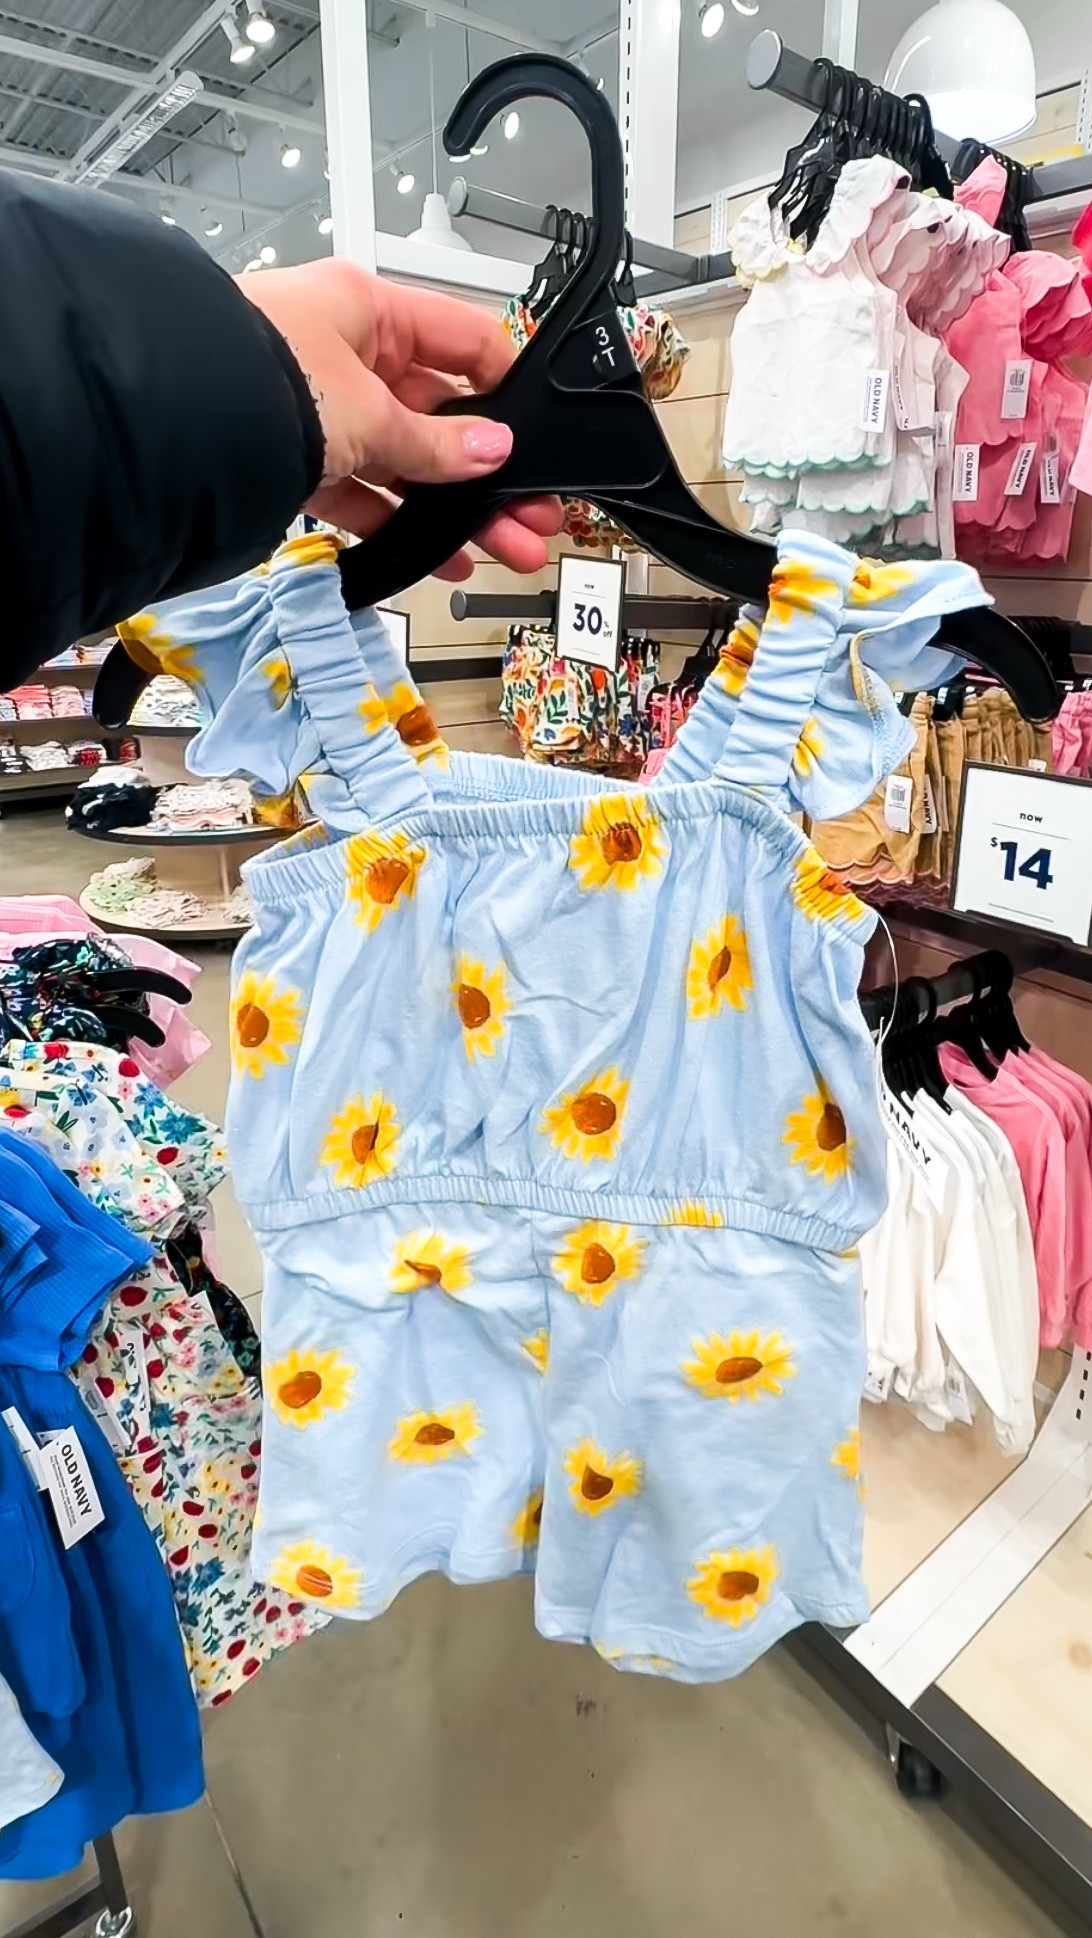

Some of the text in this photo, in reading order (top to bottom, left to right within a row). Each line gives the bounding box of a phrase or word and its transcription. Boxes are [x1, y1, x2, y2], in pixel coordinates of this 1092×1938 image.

[870, 377, 883, 424] OLD NAVY
[965, 451, 974, 493] OLD NAVY
[1020, 812, 1043, 824] now
[61, 1443, 79, 1475] OLD
[70, 1473, 93, 1516] NAVY
